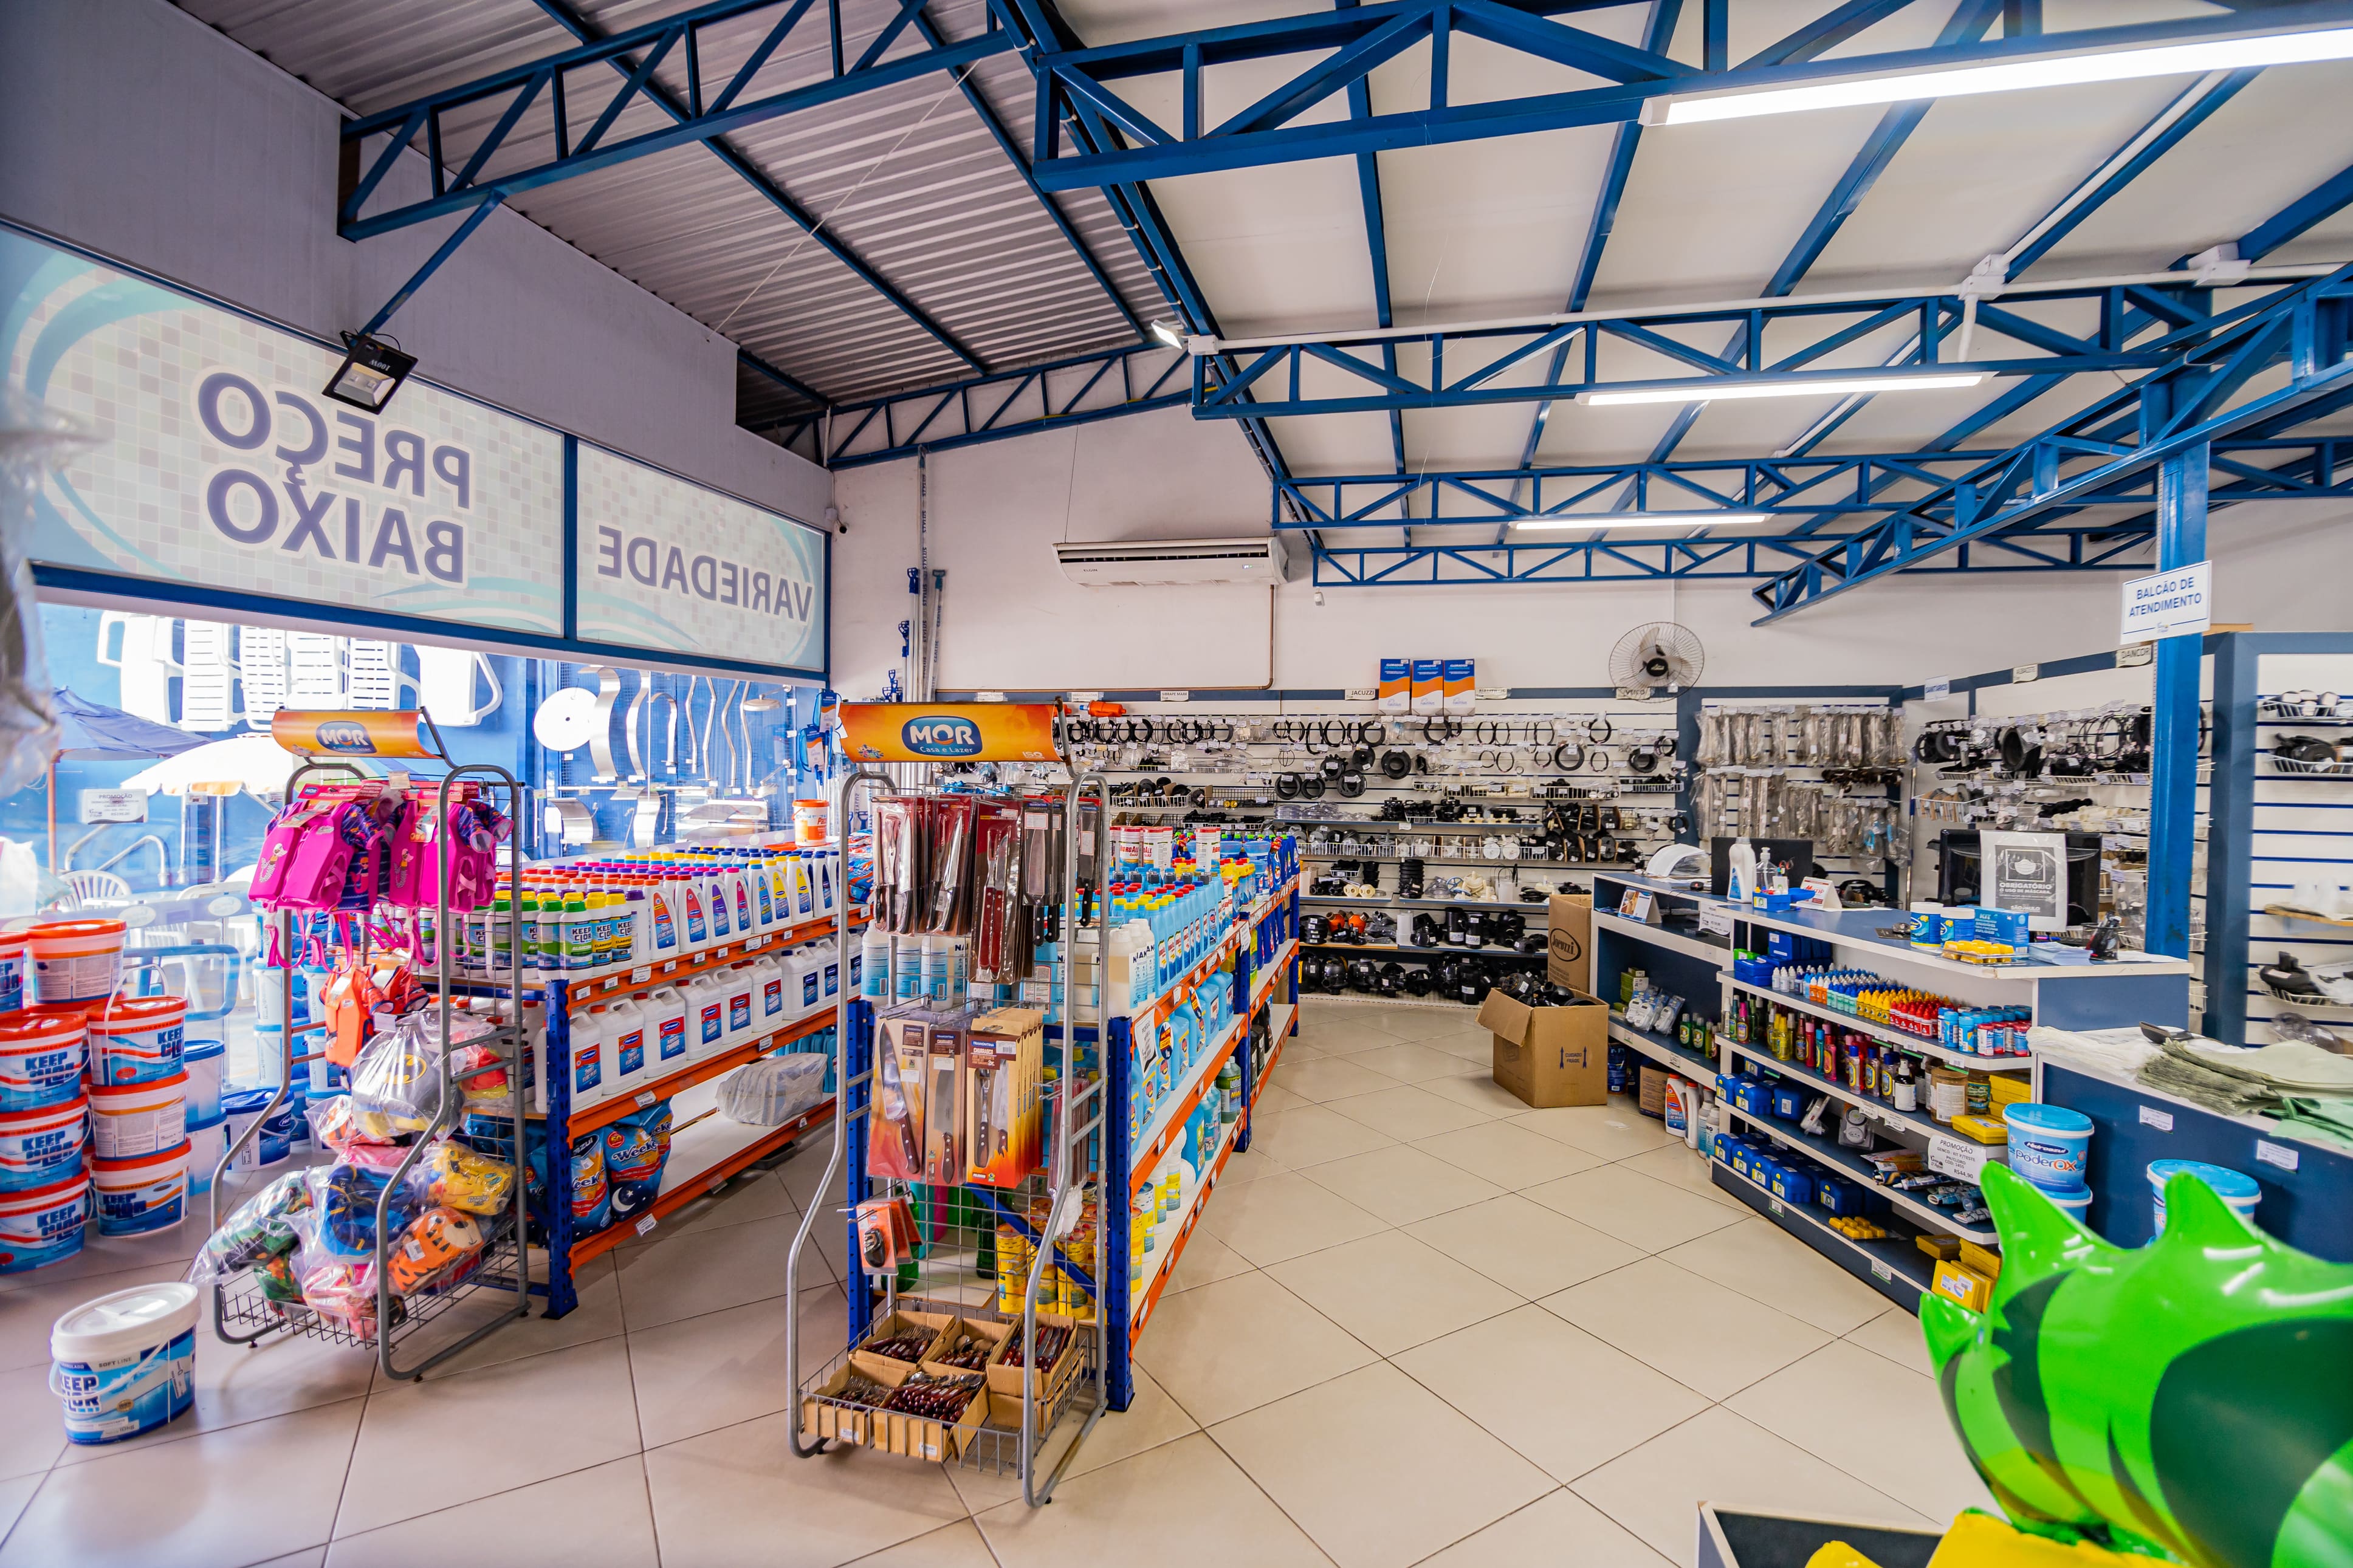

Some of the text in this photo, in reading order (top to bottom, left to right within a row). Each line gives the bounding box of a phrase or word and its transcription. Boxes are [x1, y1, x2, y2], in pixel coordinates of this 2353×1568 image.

[369, 359, 391, 371] 100W
[2137, 577, 2195, 600] BALCÃO DE
[2129, 592, 2202, 617] ATENDIMENTO
[321, 728, 369, 745] MOR
[910, 724, 975, 745] MOR
[1552, 934, 1575, 954] Jacuzzi
[25, 1051, 68, 1070] KEEP
[22, 1131, 66, 1151] KEEP
[1940, 1140, 1973, 1154] PROMOÇÃO
[2026, 1142, 2066, 1154] Hidroazul
[103, 1192, 137, 1205] KEEP
[37, 1204, 76, 1228] KEEP
[117, 1357, 132, 1365] LINE
